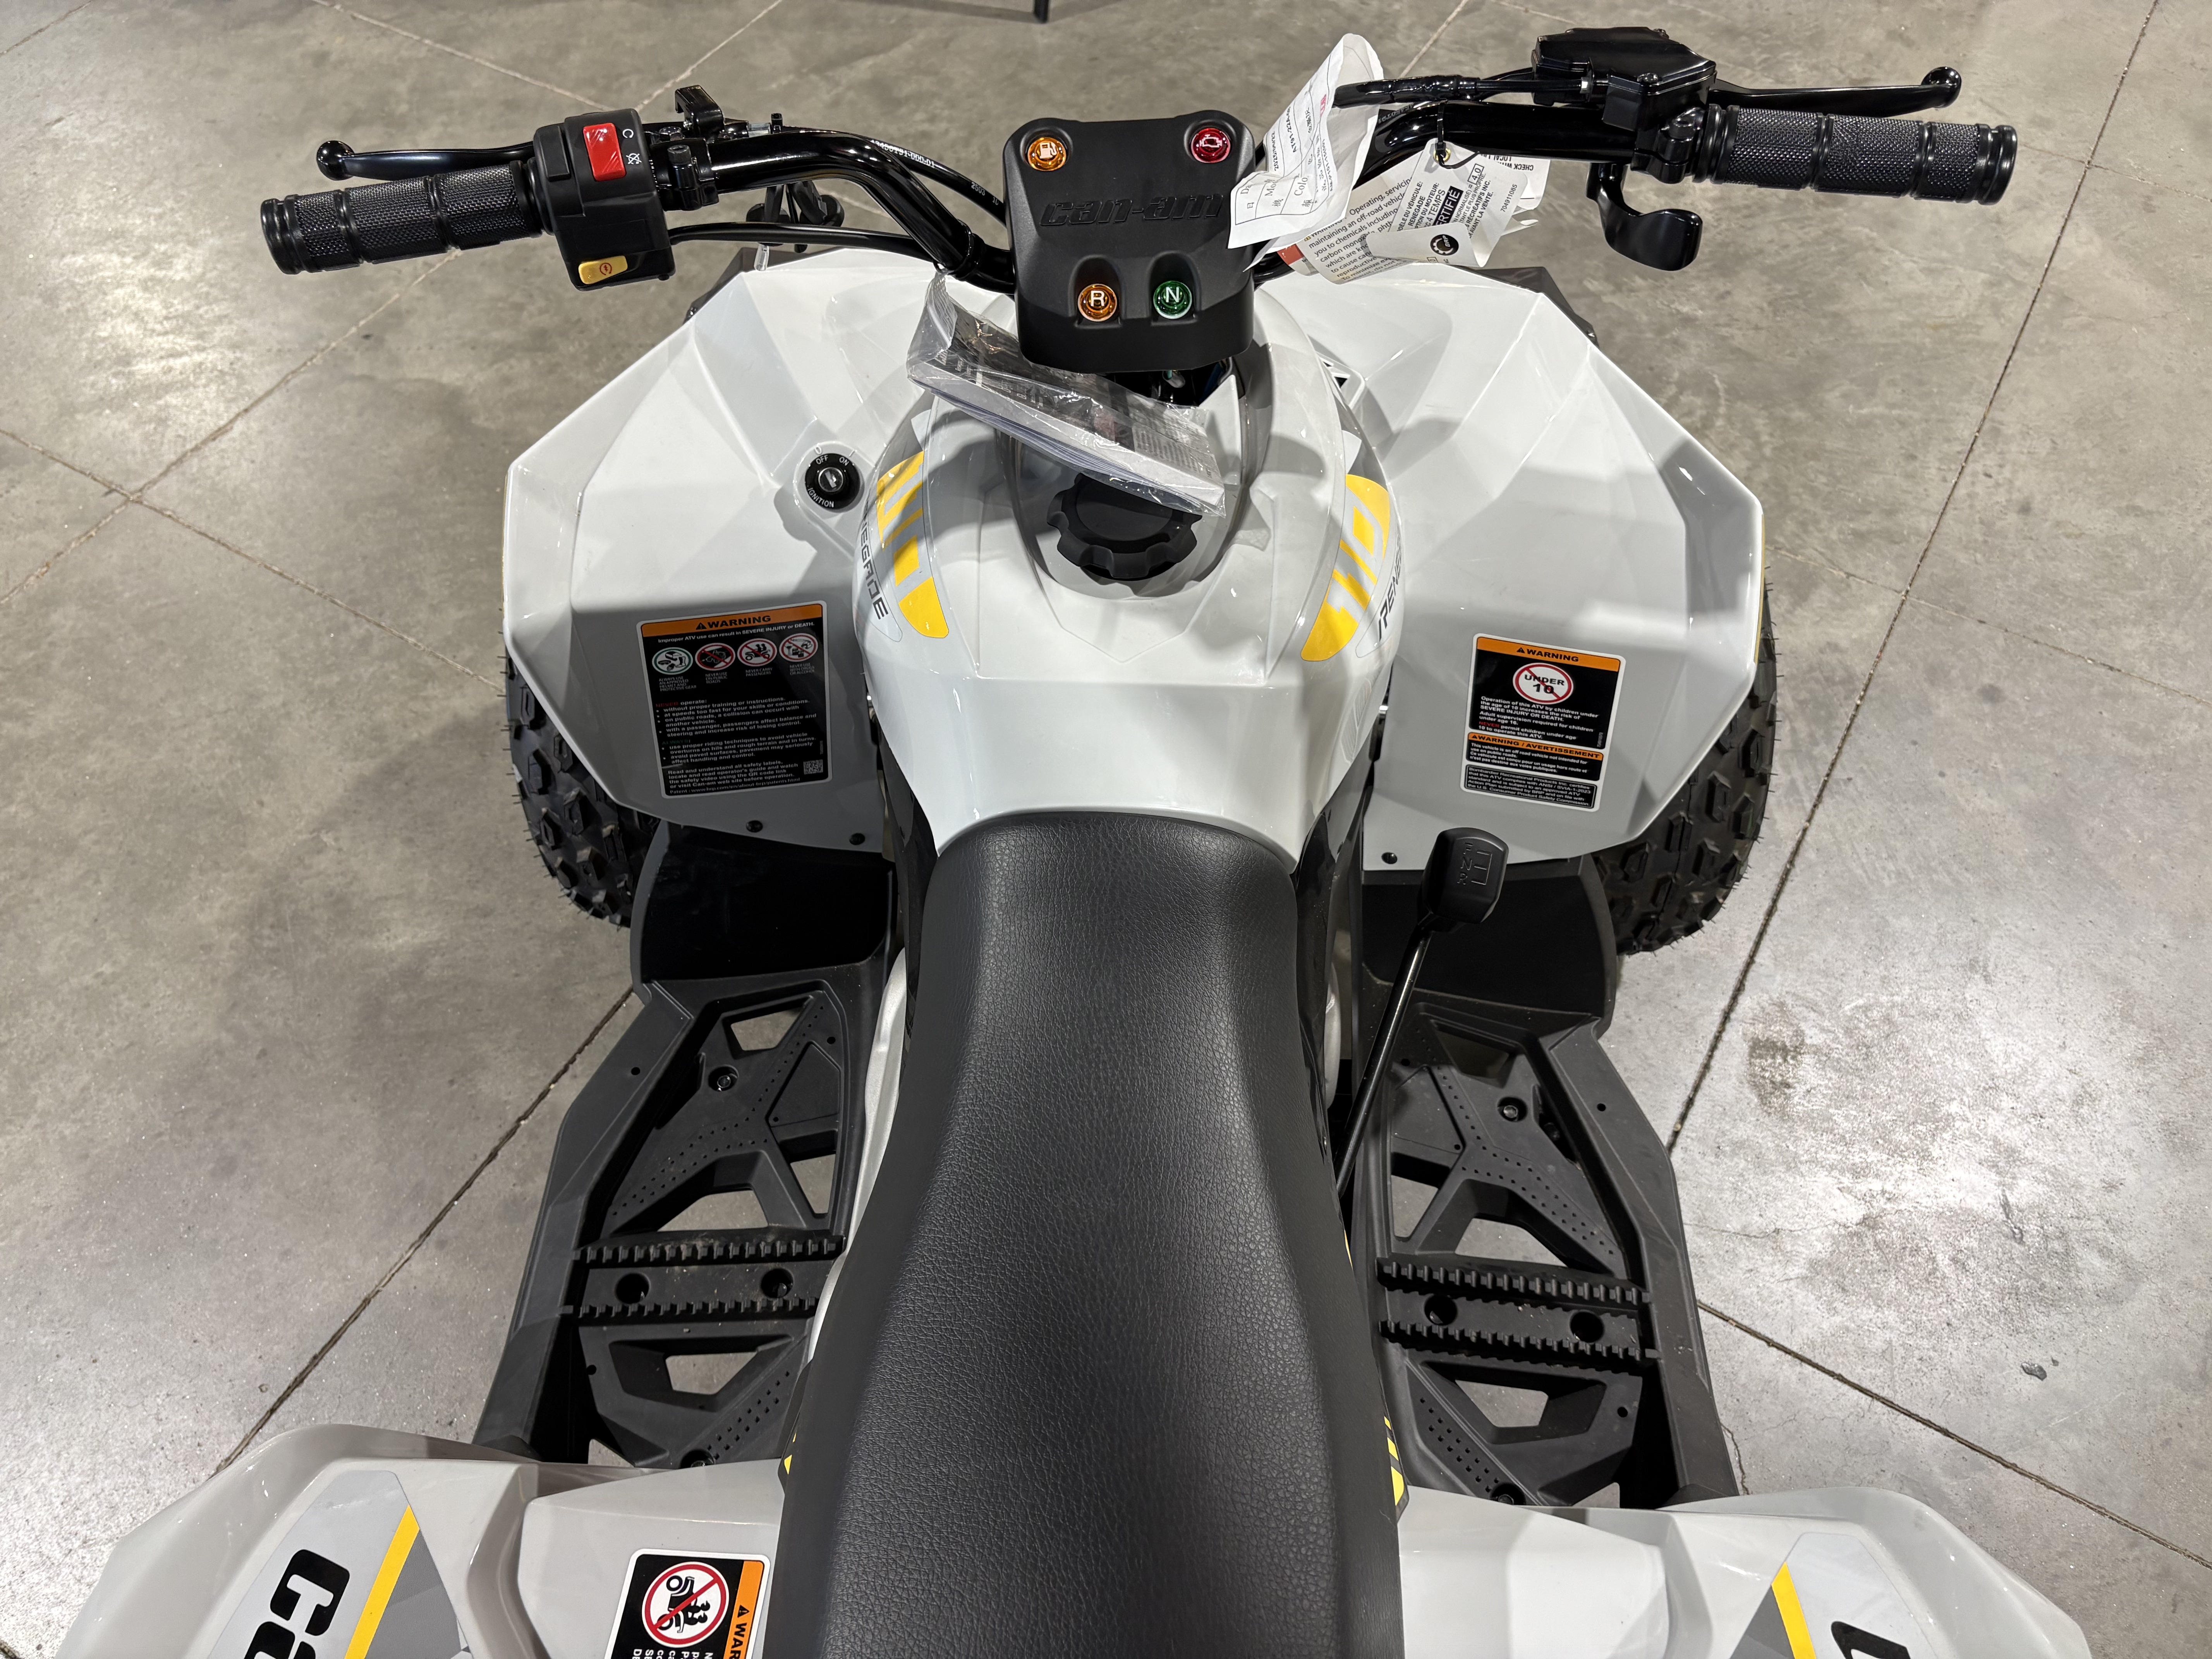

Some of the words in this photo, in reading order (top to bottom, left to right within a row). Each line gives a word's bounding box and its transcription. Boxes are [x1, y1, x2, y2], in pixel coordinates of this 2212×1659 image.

[1471, 167, 1481, 180] 4.0
[971, 182, 985, 196] 2503
[1294, 177, 1308, 196] Colo
[1467, 193, 1476, 206] PLUS
[1473, 172, 1486, 194] PROPRE.
[1349, 194, 1385, 215] Operating,
[1384, 176, 1412, 196] servicin
[1427, 189, 1446, 215] TEMPS
[1466, 191, 1485, 224] RÉCRÉATIFS
[1481, 180, 1491, 191] INC.
[1396, 217, 1407, 232] DÈLE
[1403, 210, 1410, 218] DU
[1407, 181, 1423, 209] VÉHICULE:
[1408, 195, 1425, 226] RENEGADE
[1414, 215, 1424, 229] PTION
[1420, 207, 1428, 216] DU
[1424, 182, 1439, 208] MOTEUR:
[1436, 189, 1460, 227] ERTIFIÉ
[1470, 218, 1480, 233] AVANT
[1480, 191, 1494, 210] VENTE.
[1309, 225, 1348, 249] maintaining
[1356, 204, 1383, 223] off-road
[1314, 246, 1328, 257] you
[1335, 225, 1367, 244] chemicals
[1320, 248, 1343, 262] carbon
[1325, 256, 1345, 268] which
[1339, 258, 1358, 269] cause
[1350, 262, 1380, 280] minimize
[1091, 290, 1105, 306] R
[1166, 287, 1179, 303] N
[816, 455, 828, 464] OFF
[839, 457, 849, 466] ON
[807, 488, 834, 507] IGNITION
[707, 615, 771, 628] WARNING
[1527, 649, 1578, 662] WARNING
[1524, 674, 1565, 686] UNDER
[1532, 682, 1554, 695] 10
[1480, 696, 1510, 704] Operation
[1480, 704, 1504, 713] SEVERE
[1496, 714, 1531, 722] supervision
[1477, 735, 1519, 746] WARNING
[1525, 743, 1599, 758] AVERTISSEMENT
[1460, 856, 1472, 871] N
[1457, 872, 1468, 885] R
